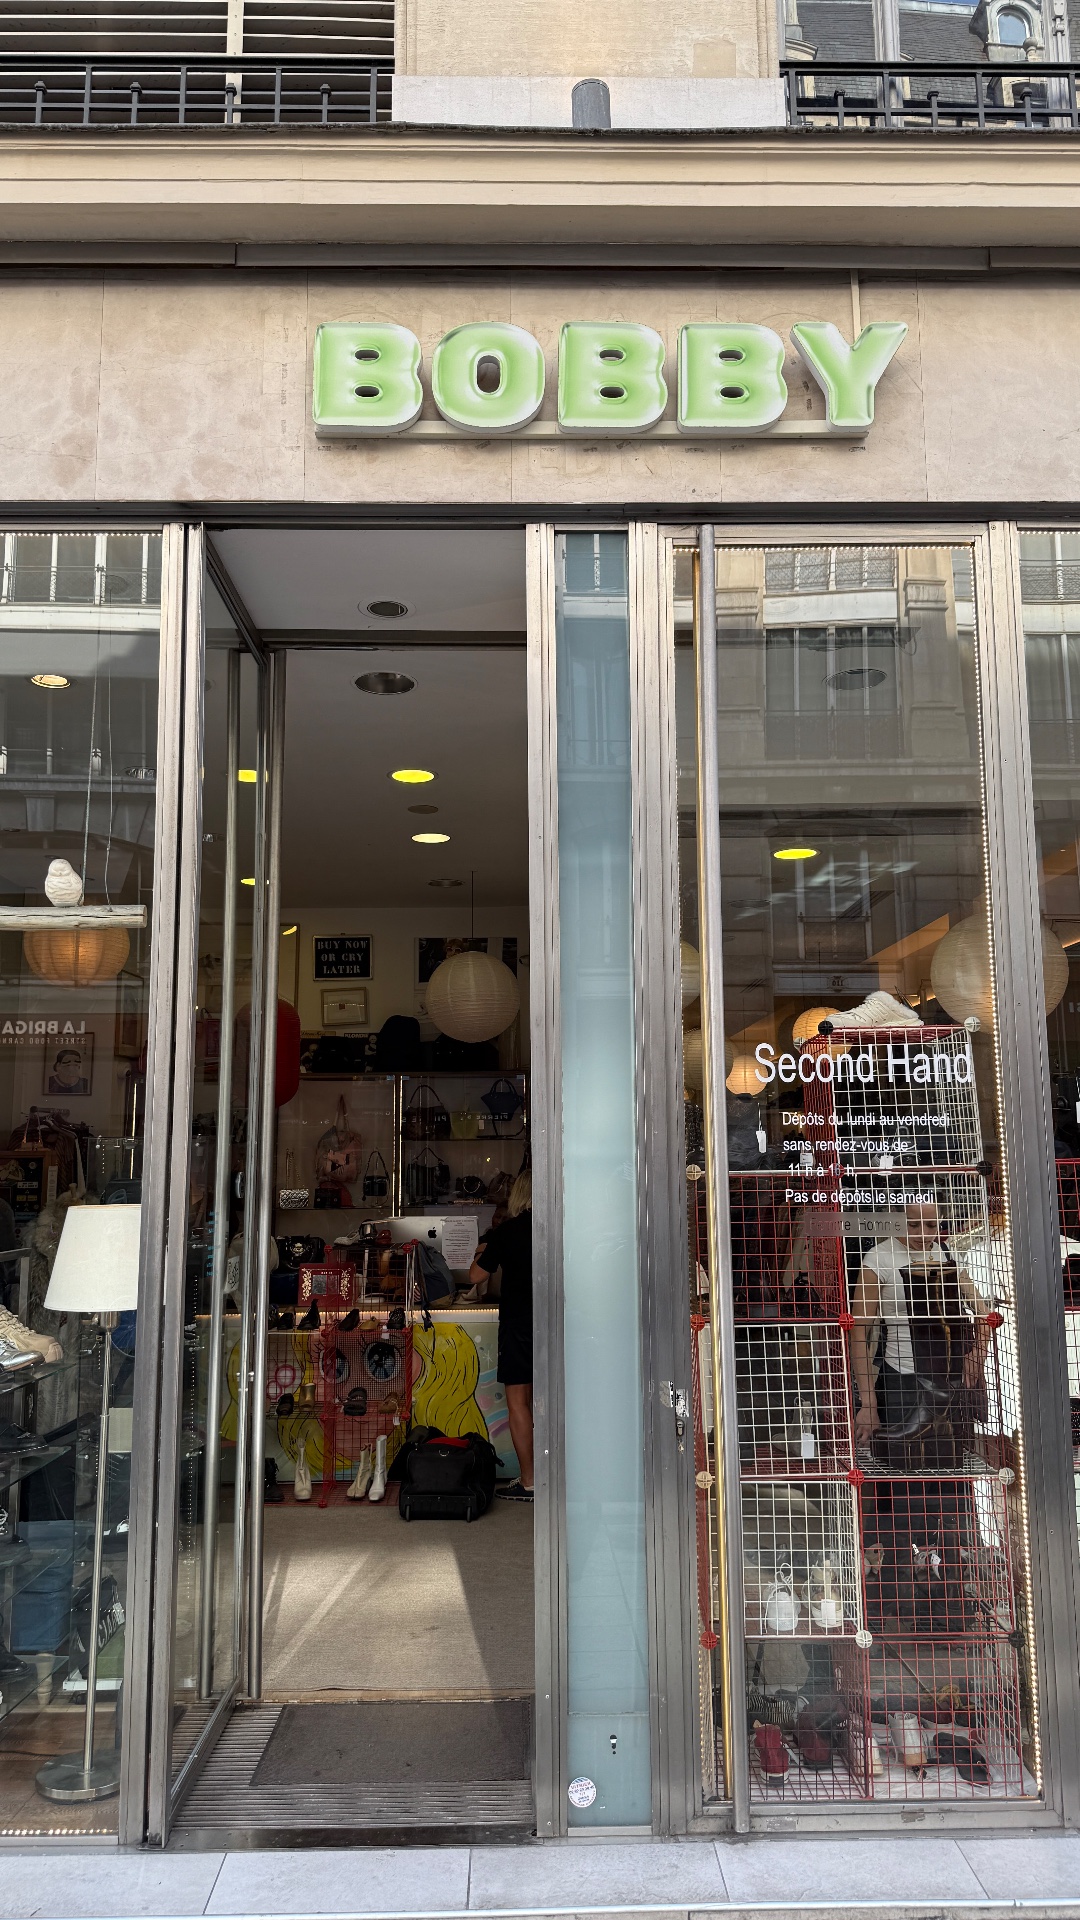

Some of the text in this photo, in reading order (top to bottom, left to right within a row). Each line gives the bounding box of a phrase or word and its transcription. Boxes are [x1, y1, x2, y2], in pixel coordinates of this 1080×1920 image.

[312, 321, 909, 434] BOBBY
[317, 940, 368, 950] BUY NOW
[320, 953, 364, 962] OR CRY
[323, 965, 361, 974] LATER
[754, 1043, 972, 1083] Second Hand
[782, 1111, 950, 1128] Dépôts du lundi au vendredi
[783, 1137, 908, 1151] sans rendez-vous de
[789, 1163, 801, 1177] 11
[805, 1163, 813, 1177] h
[817, 1163, 825, 1177] à
[847, 1163, 855, 1177] h
[785, 1189, 934, 1206] Pas de dépôts le samedi
[857, 1218, 901, 1231] Homme
